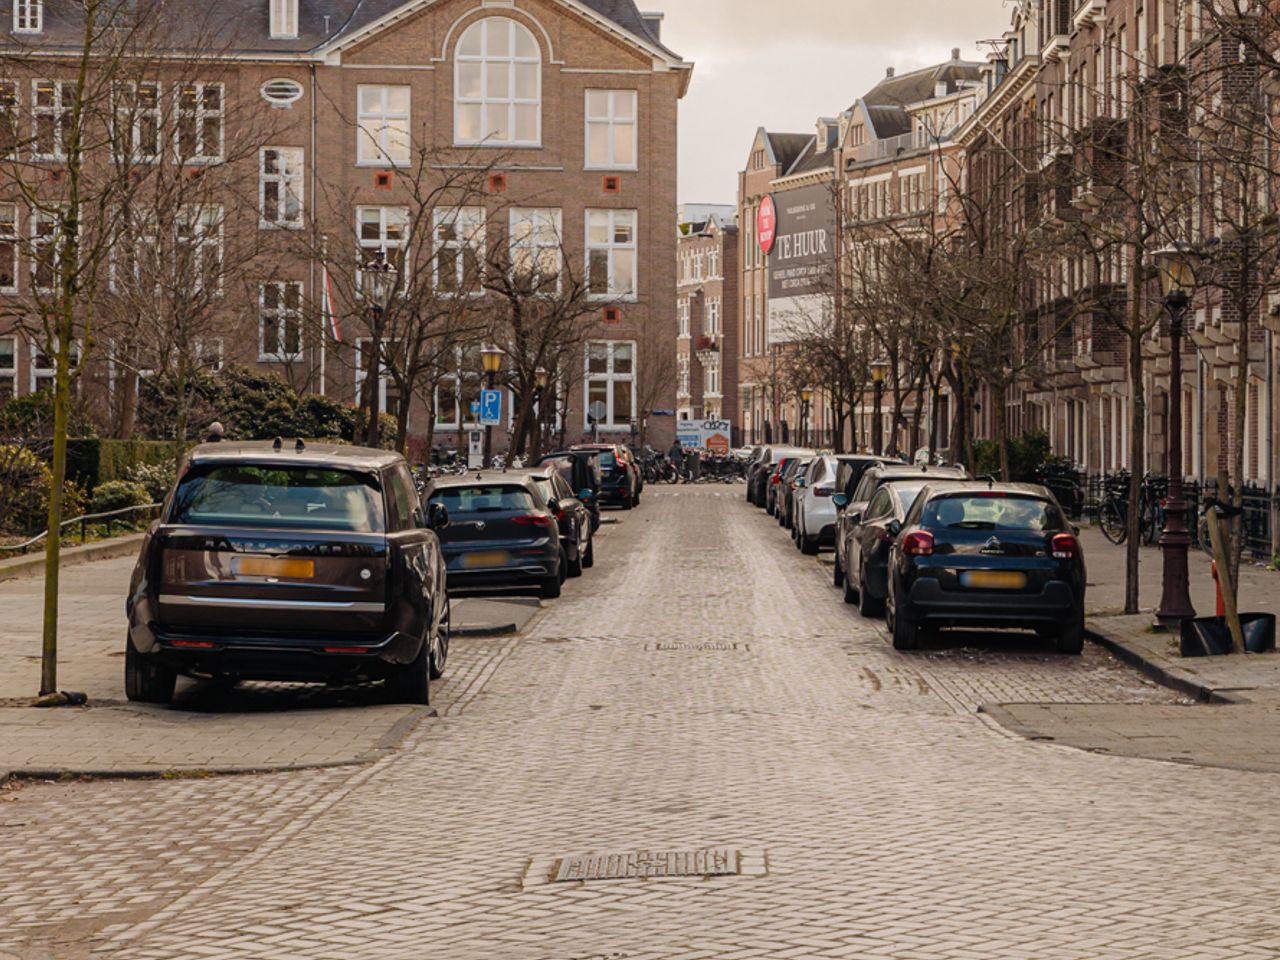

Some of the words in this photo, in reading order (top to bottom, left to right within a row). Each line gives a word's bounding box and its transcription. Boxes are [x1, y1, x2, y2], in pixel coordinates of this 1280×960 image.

[776, 234, 791, 260] TE
[793, 229, 827, 258] HUUR
[485, 392, 497, 407] P
